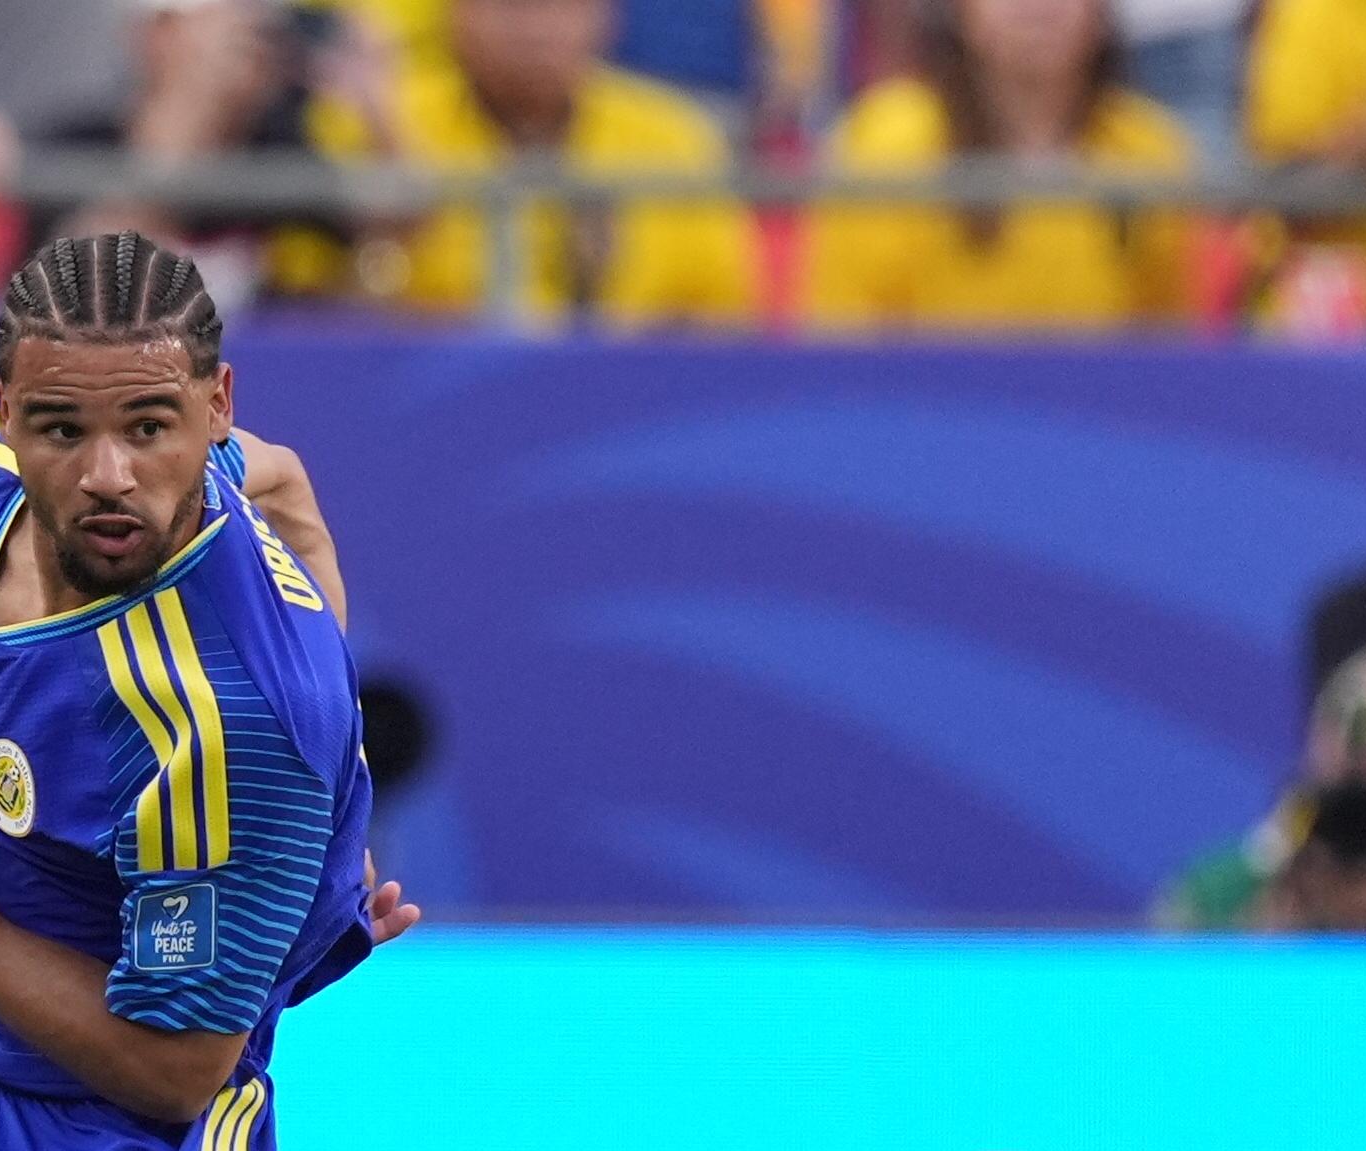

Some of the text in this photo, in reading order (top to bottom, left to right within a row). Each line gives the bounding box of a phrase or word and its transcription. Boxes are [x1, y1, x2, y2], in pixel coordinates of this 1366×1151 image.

[151, 920, 181, 937] Unite
[155, 937, 195, 953] PEACE
[163, 954, 185, 963] FIFA
